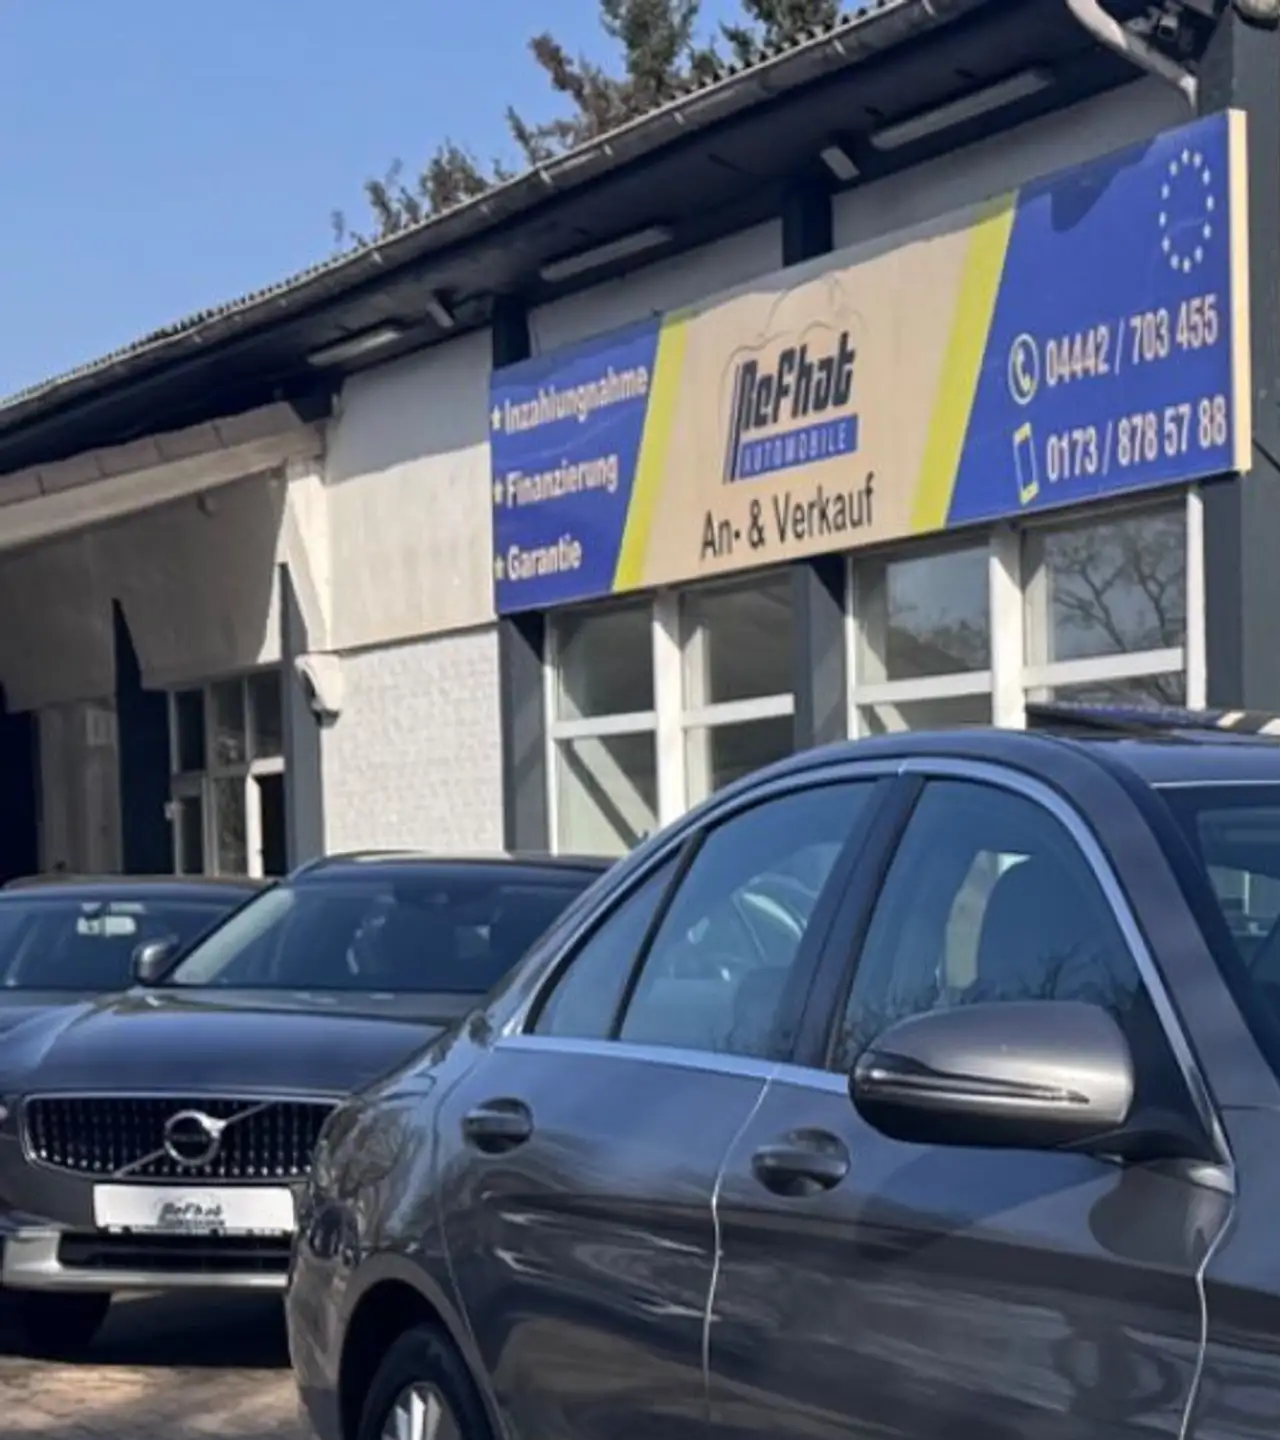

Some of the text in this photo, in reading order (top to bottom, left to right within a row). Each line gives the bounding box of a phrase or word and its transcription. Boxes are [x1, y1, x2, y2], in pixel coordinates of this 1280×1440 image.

[1046, 325, 1110, 387] 04442
[1130, 307, 1169, 366] 703
[1176, 294, 1218, 350] 455
[504, 365, 649, 436] Inzahlungnahme
[742, 422, 849, 474] AUTOMOBILE
[1047, 425, 1098, 483] 0173
[1118, 412, 1158, 467] 878
[1163, 403, 1191, 457] 57
[1198, 393, 1227, 448] 88
[506, 453, 619, 509] Finanzierung
[700, 470, 875, 561] An- & Verkauf
[507, 532, 582, 581] Garantie
